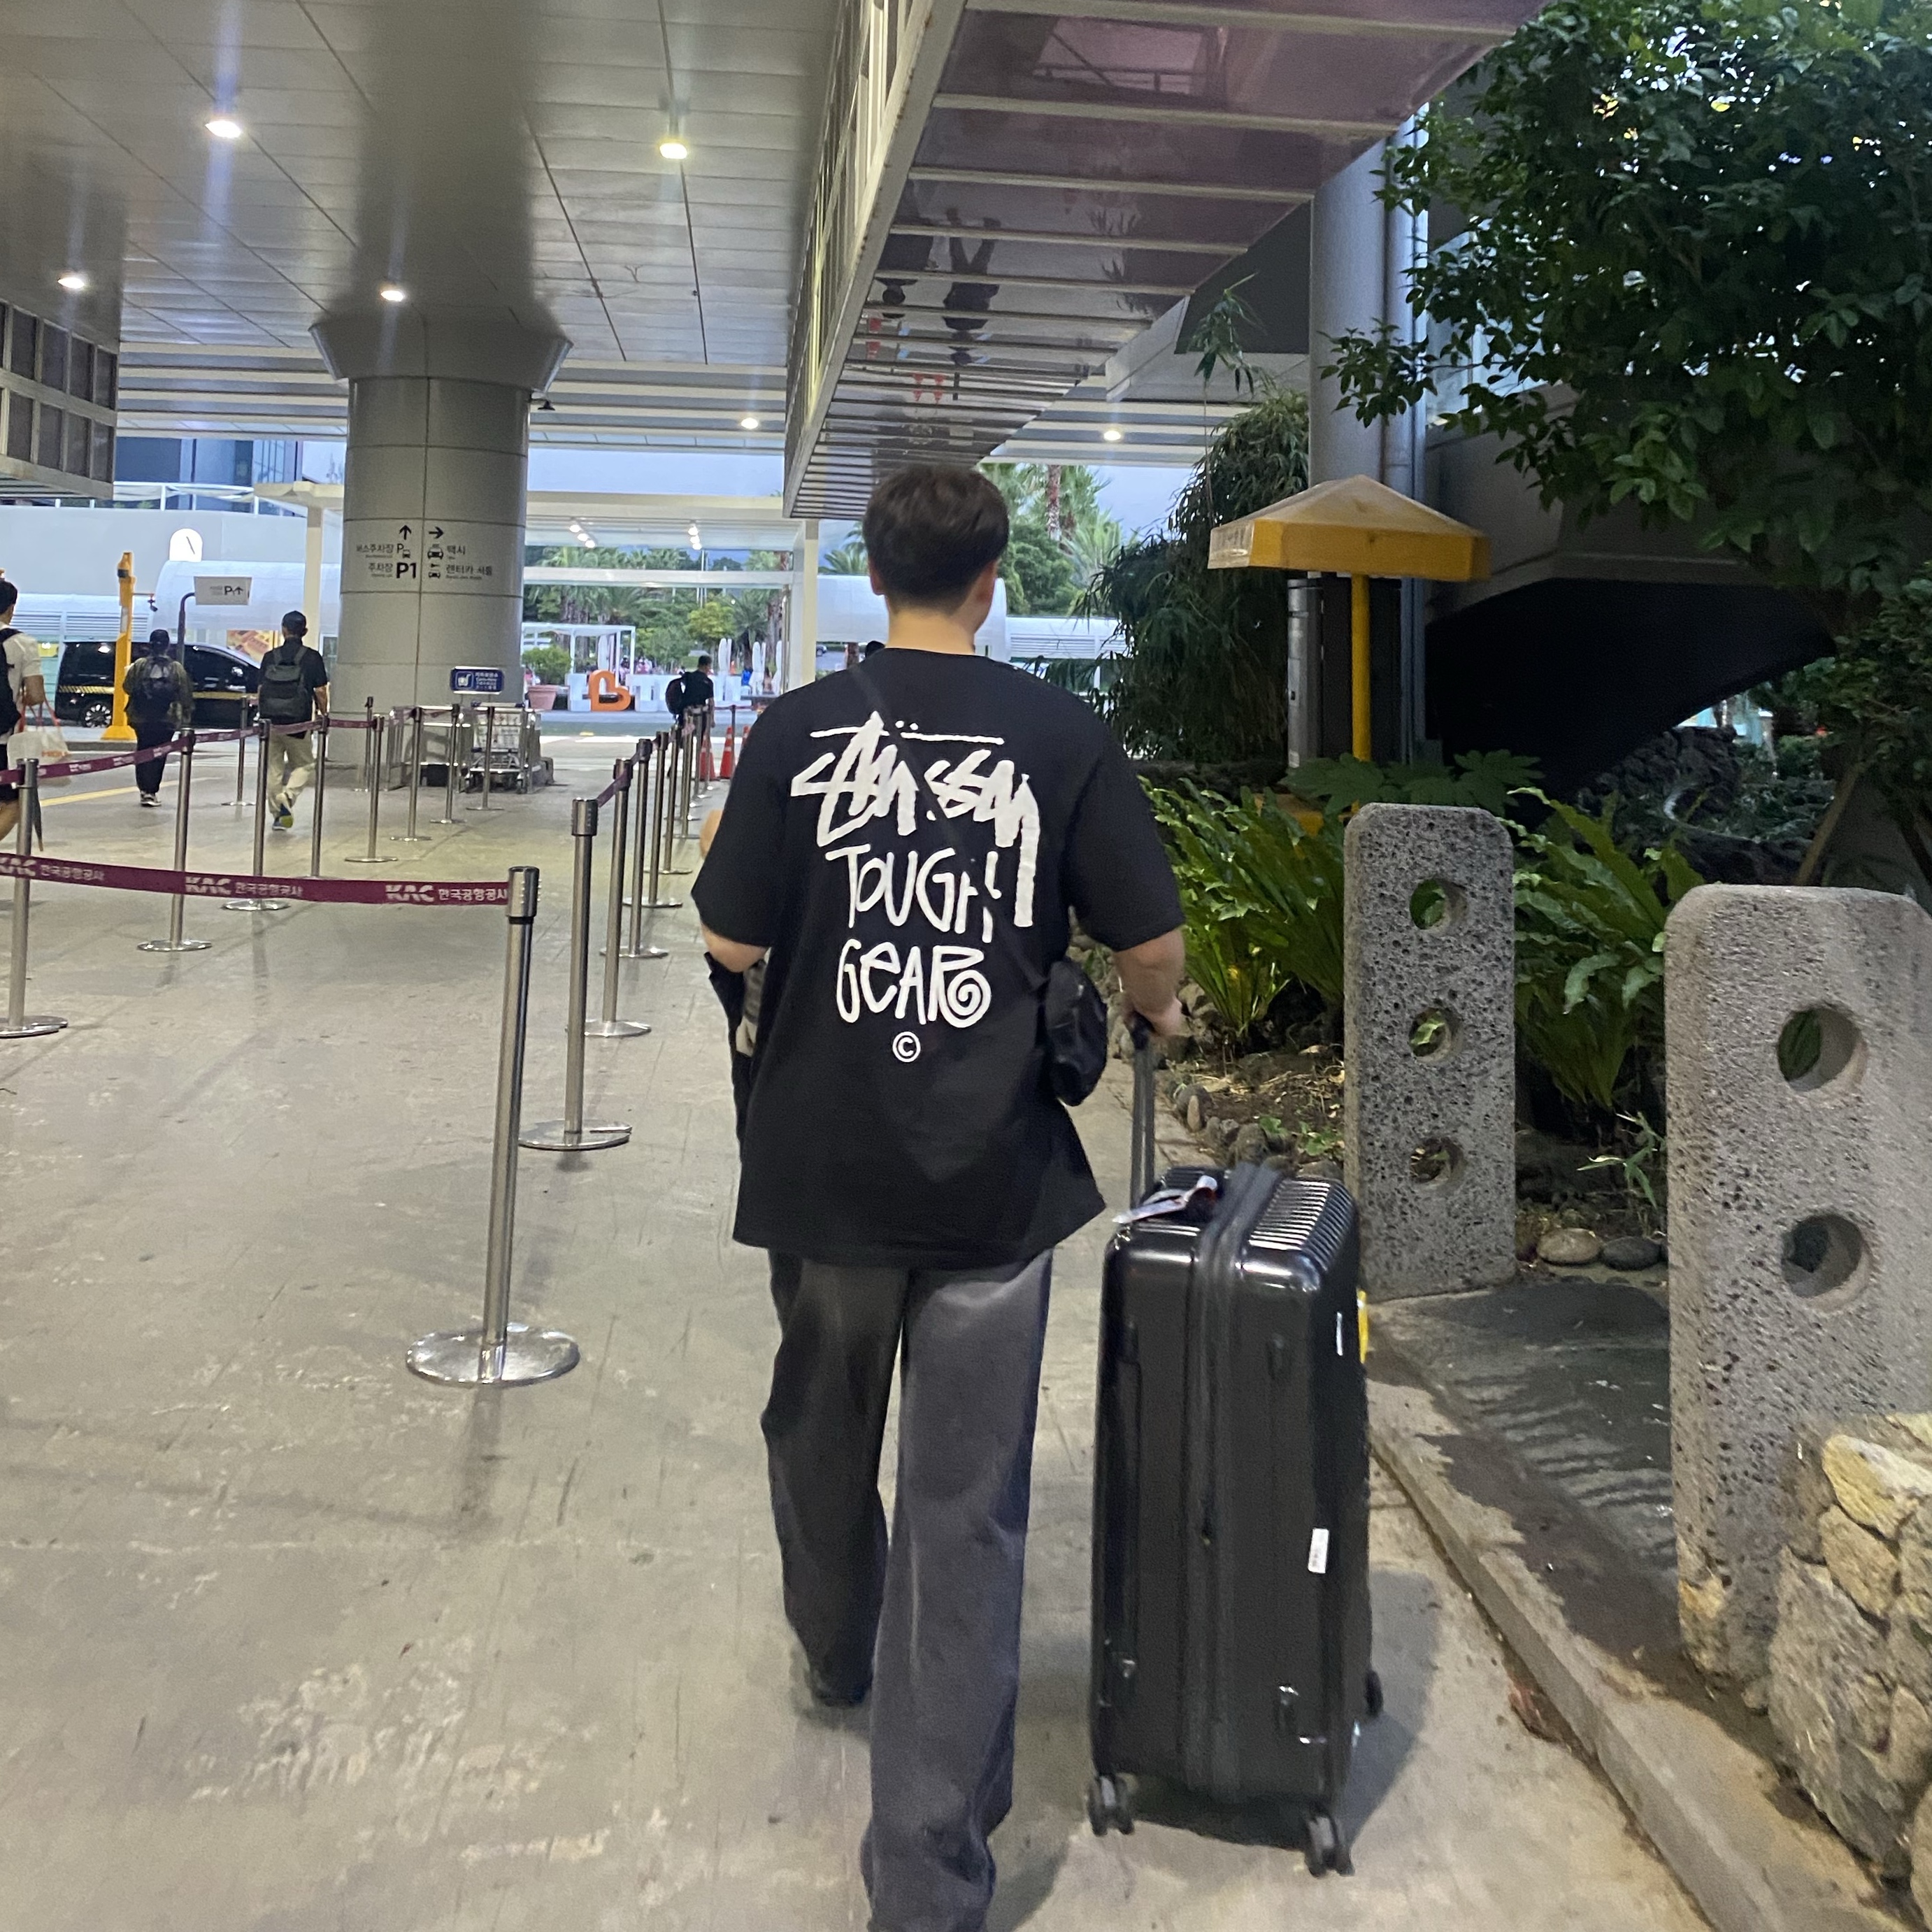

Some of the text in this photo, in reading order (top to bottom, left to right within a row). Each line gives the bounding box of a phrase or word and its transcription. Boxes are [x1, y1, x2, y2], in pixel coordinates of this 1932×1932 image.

[396, 562, 417, 579] P1
[185, 875, 231, 895] KAC
[385, 884, 434, 902] KAC
